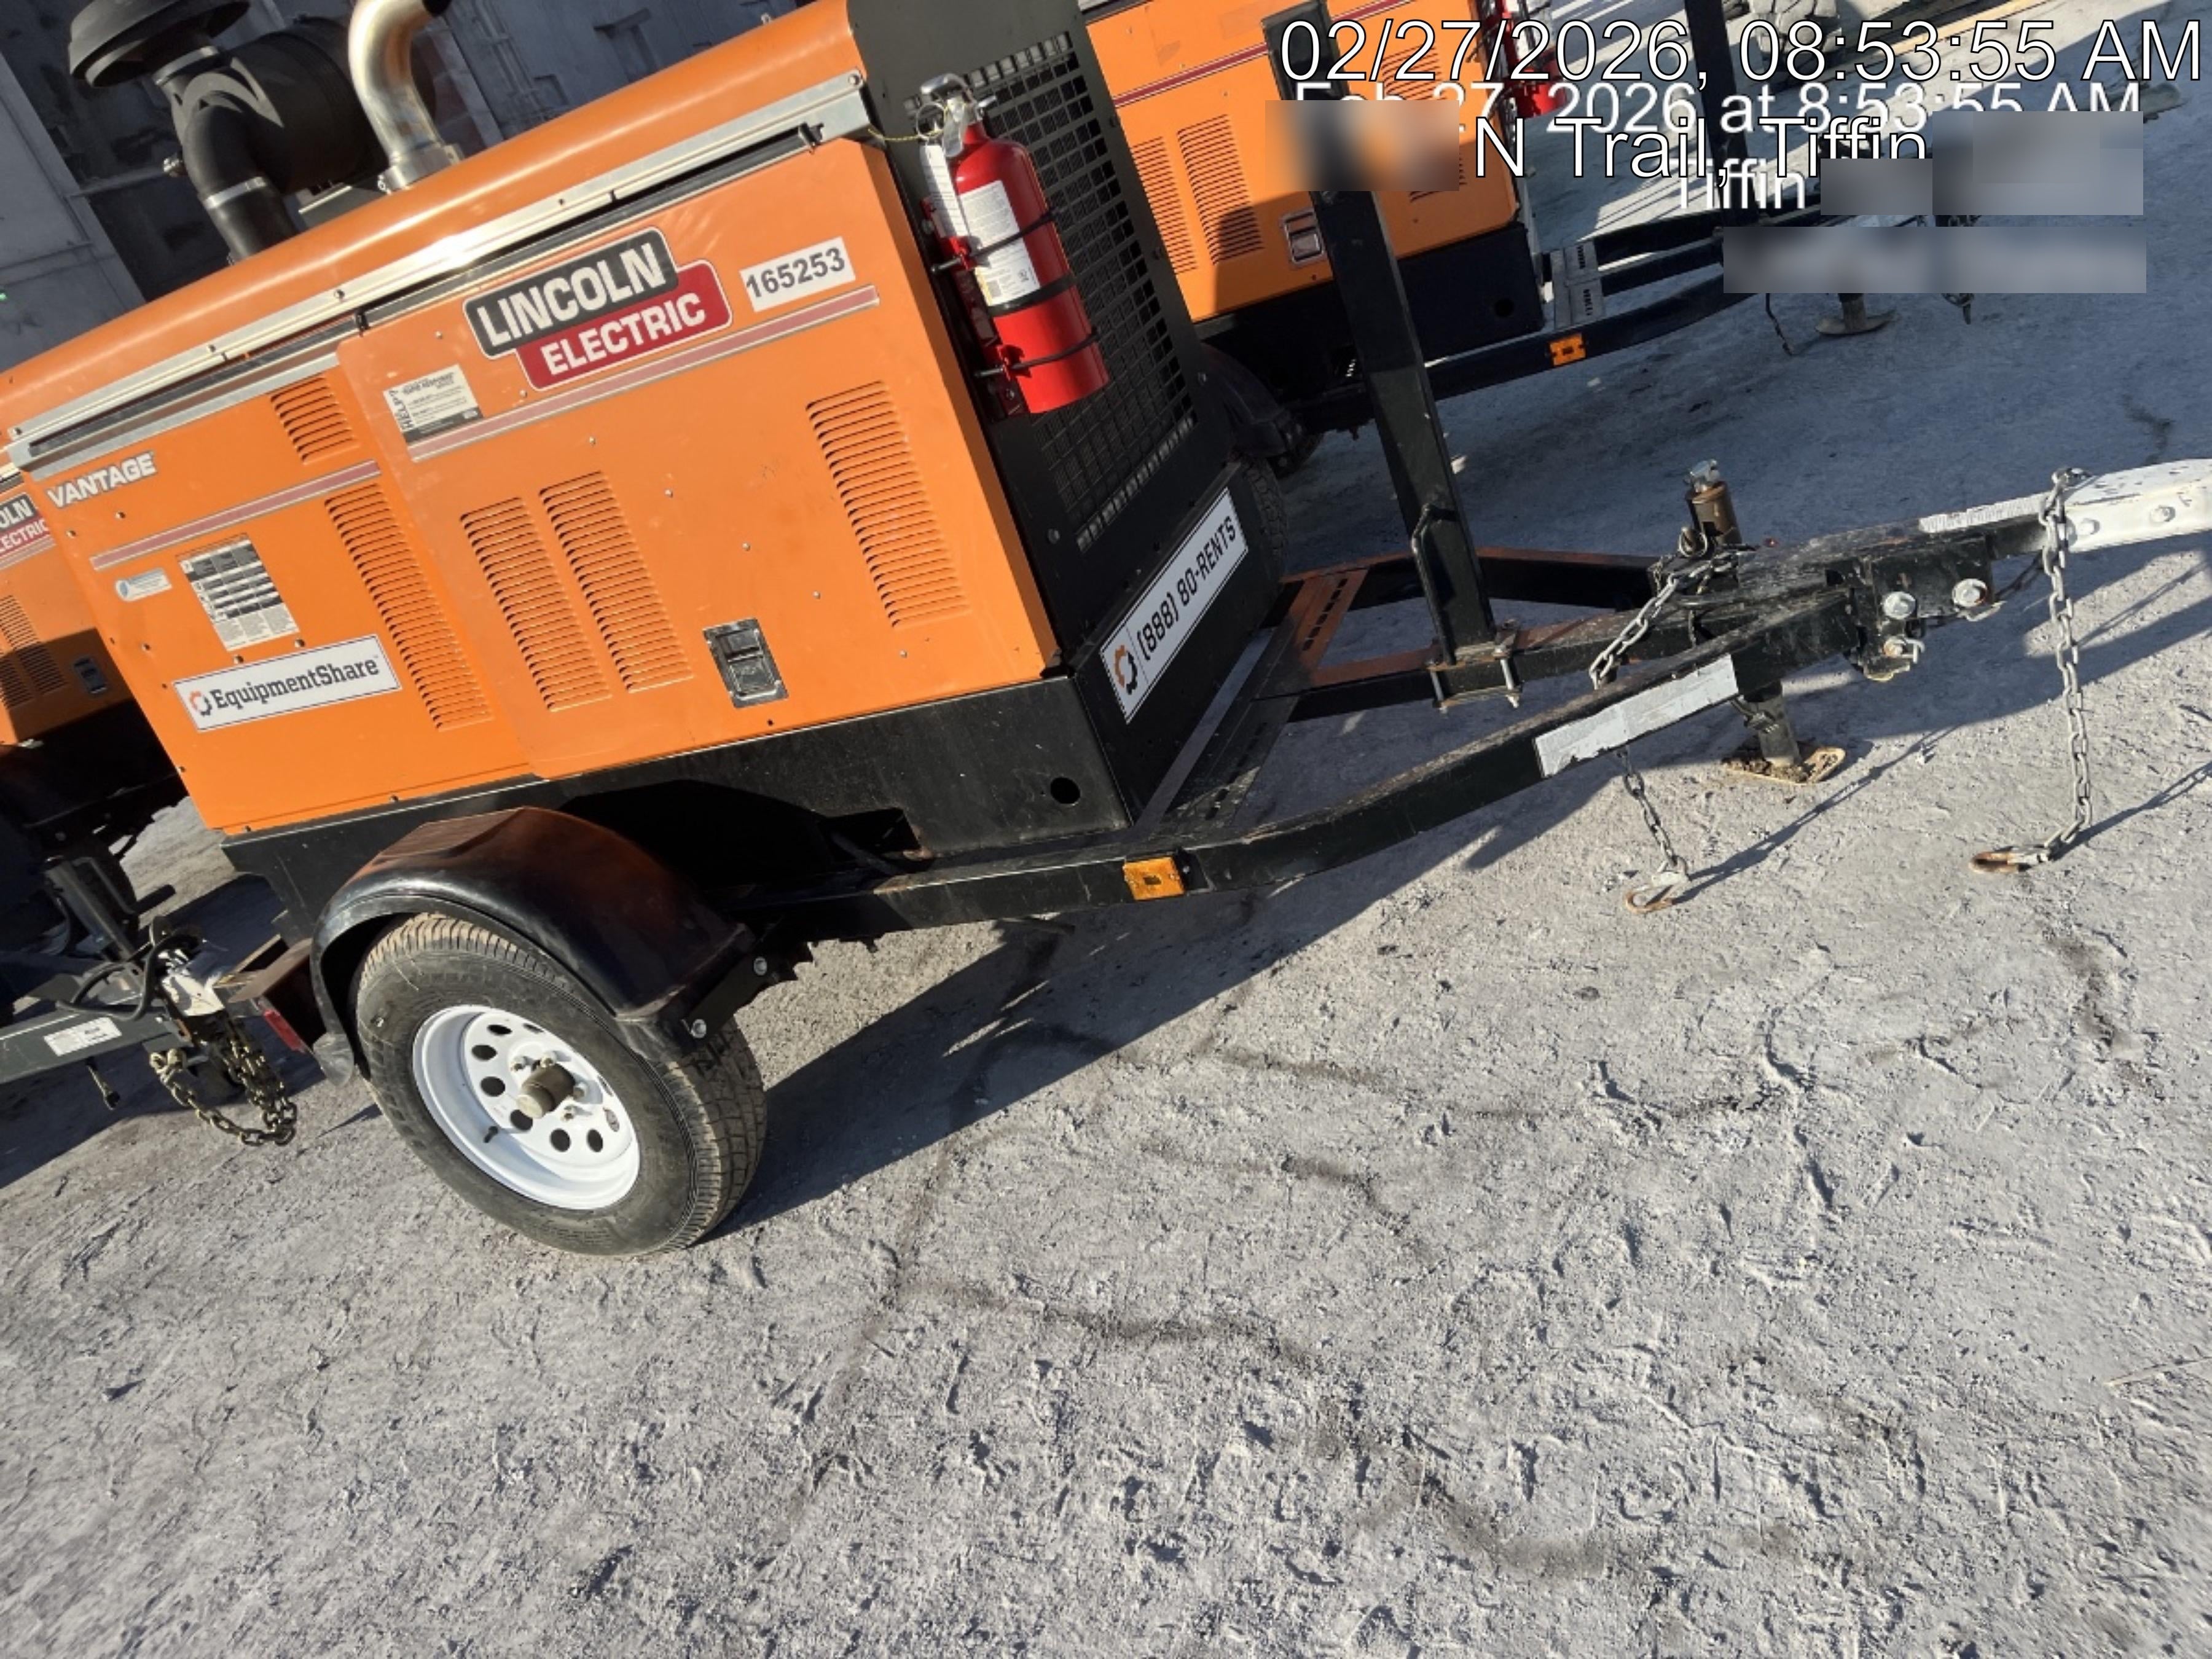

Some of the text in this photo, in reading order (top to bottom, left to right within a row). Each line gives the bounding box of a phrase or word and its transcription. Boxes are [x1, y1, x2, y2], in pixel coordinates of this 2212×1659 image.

[476, 242, 667, 347] LINCOLN
[745, 248, 846, 299] 165253
[541, 292, 707, 376] ELECTRIC
[47, 453, 158, 508] VANTAGE
[0, 518, 49, 552] ECTRIC
[1137, 516, 1237, 661] (888) 80-RENTS
[210, 658, 380, 710] EquipmentShare
